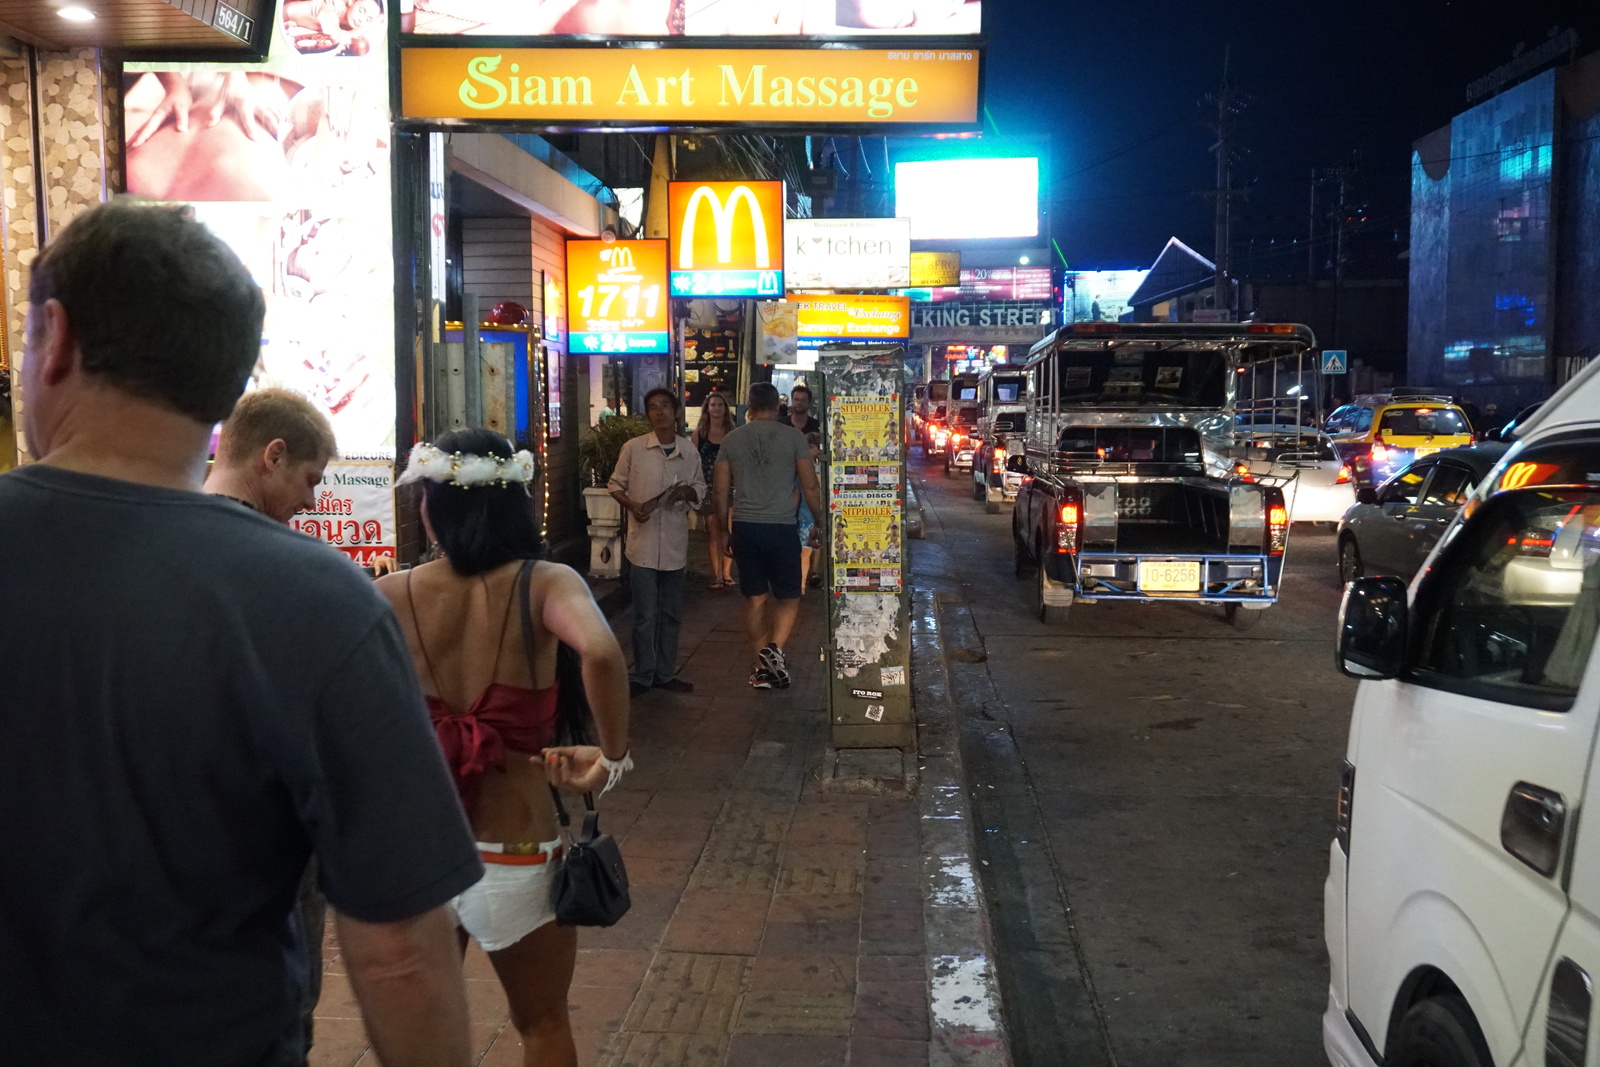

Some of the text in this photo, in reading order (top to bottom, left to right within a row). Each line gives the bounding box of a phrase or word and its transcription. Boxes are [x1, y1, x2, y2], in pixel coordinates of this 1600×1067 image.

[219, 6, 250, 40] 564/1
[458, 54, 919, 117] Siam Art Massage
[797, 235, 891, 256] ktchen
[975, 268, 987, 280] 20
[577, 284, 660, 317] 1711
[813, 302, 848, 310] TRAVEL
[854, 307, 902, 321] Exchange
[911, 309, 970, 328] LKING
[847, 322, 900, 335] Exchange
[600, 333, 628, 352] 24
[841, 404, 890, 412] SITPHOLEK
[333, 473, 390, 488] Massage
[842, 507, 892, 516] SITPHOLEK
[1146, 568, 1196, 582] 10-6256
